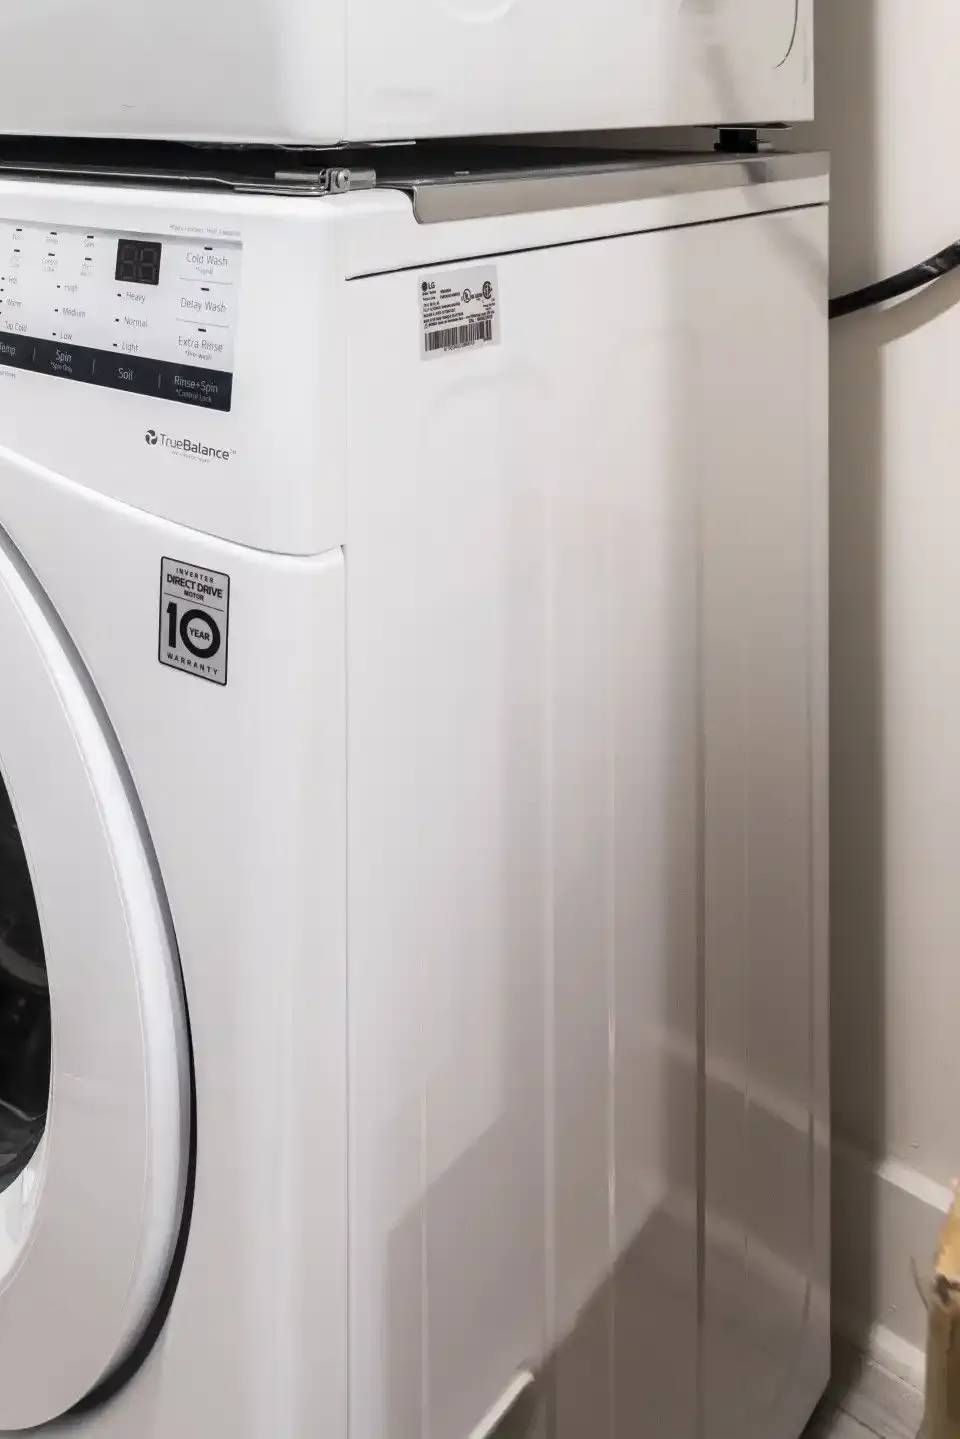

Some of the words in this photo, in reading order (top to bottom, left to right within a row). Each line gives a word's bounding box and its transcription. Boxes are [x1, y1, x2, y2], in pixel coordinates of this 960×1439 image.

[185, 251, 205, 265] Cold
[206, 255, 228, 266] Wash
[125, 292, 145, 303] Heavy
[180, 297, 203, 311] Delay
[204, 300, 227, 313] Wash
[124, 316, 148, 328] Normal
[60, 331, 72, 341] Low
[122, 341, 140, 353] Light
[178, 335, 200, 350] Extra
[200, 340, 223, 353] Rinse
[55, 349, 72, 364] Spin
[118, 367, 134, 381] Soil
[174, 374, 218, 394] Rinse+Spin
[159, 432, 230, 461] TrueBalance
[176, 567, 214, 583] INVERTER
[166, 573, 196, 591] DIRECT
[197, 582, 223, 599] DRIVE
[183, 589, 205, 601] MOTOR
[166, 601, 221, 659] 10
[189, 627, 210, 641] YEAR
[167, 651, 218, 675] WARRANTY
